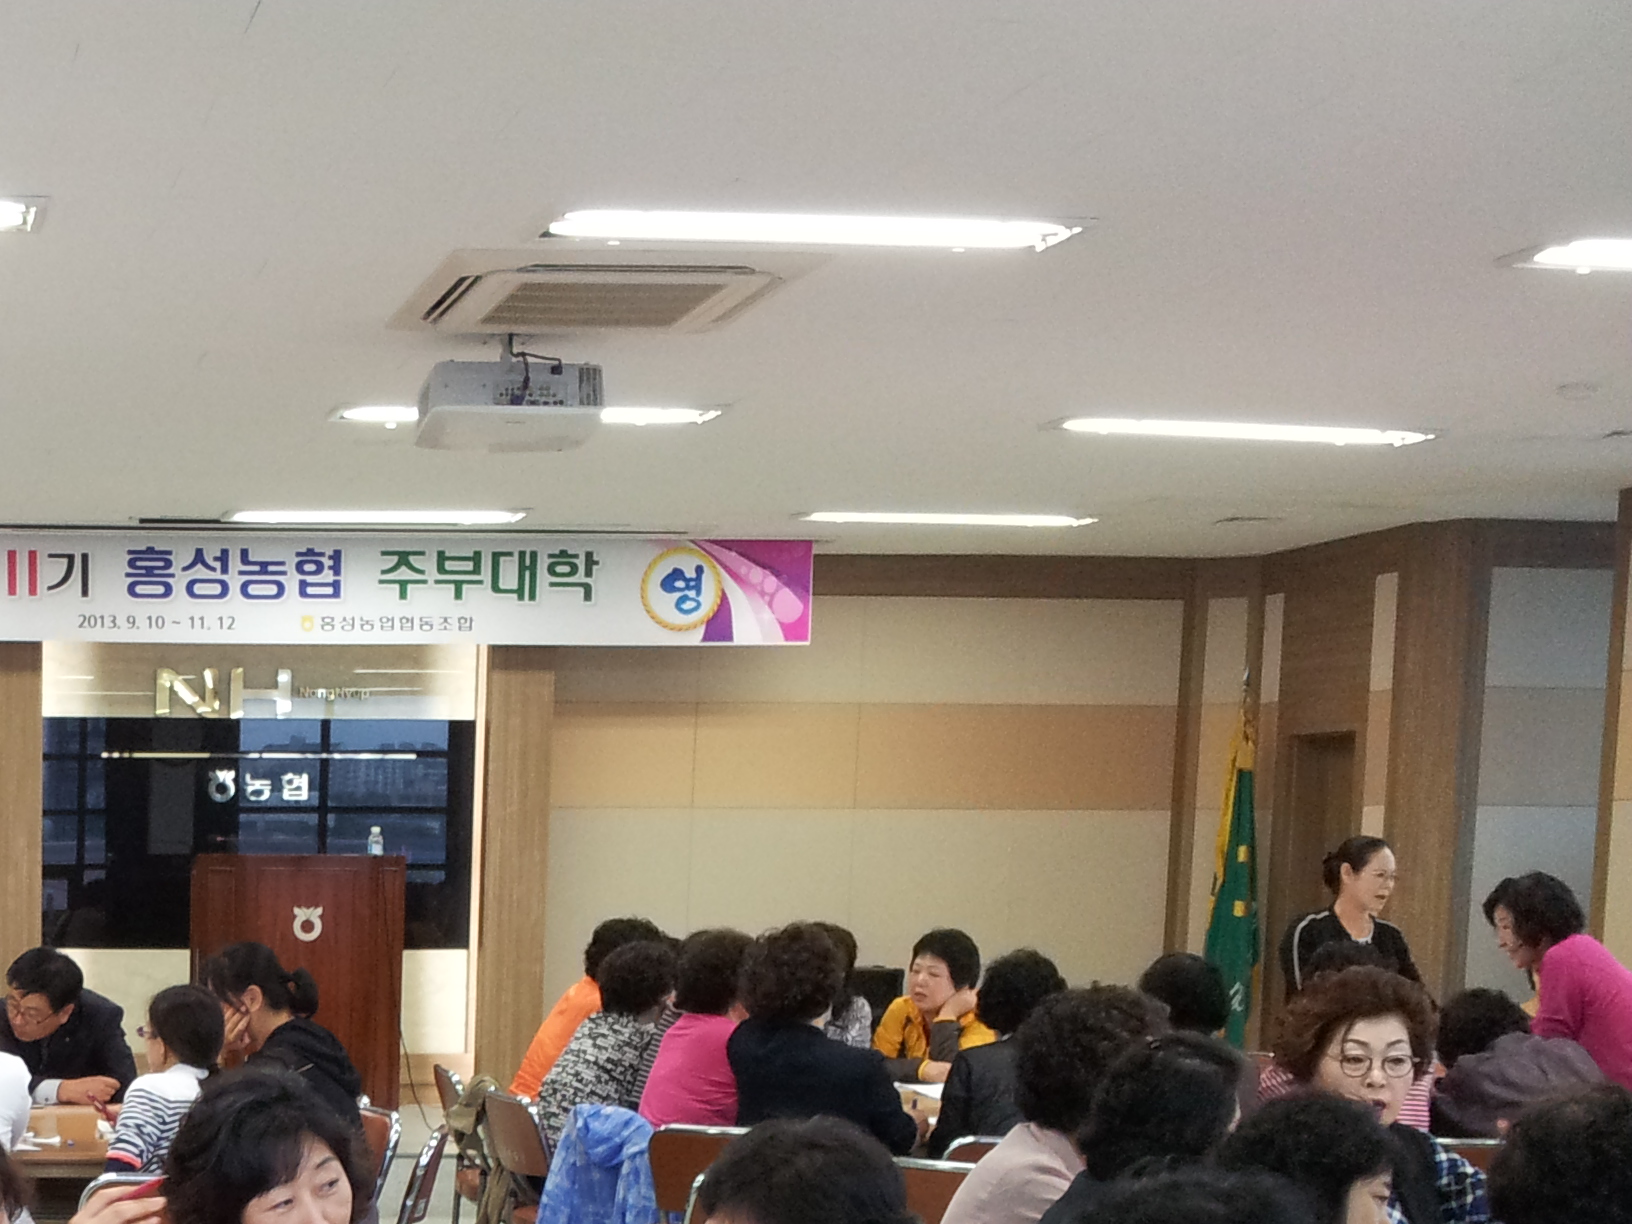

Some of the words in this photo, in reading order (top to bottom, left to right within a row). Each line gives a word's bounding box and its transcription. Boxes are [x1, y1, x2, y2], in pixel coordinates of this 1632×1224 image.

[124, 546, 343, 600] 홍성농협
[377, 548, 600, 602] 주부대학
[659, 564, 705, 615] 영
[320, 615, 474, 632] 홍성농업협동조합
[155, 667, 293, 719] NH
[244, 771, 310, 801] 농협
